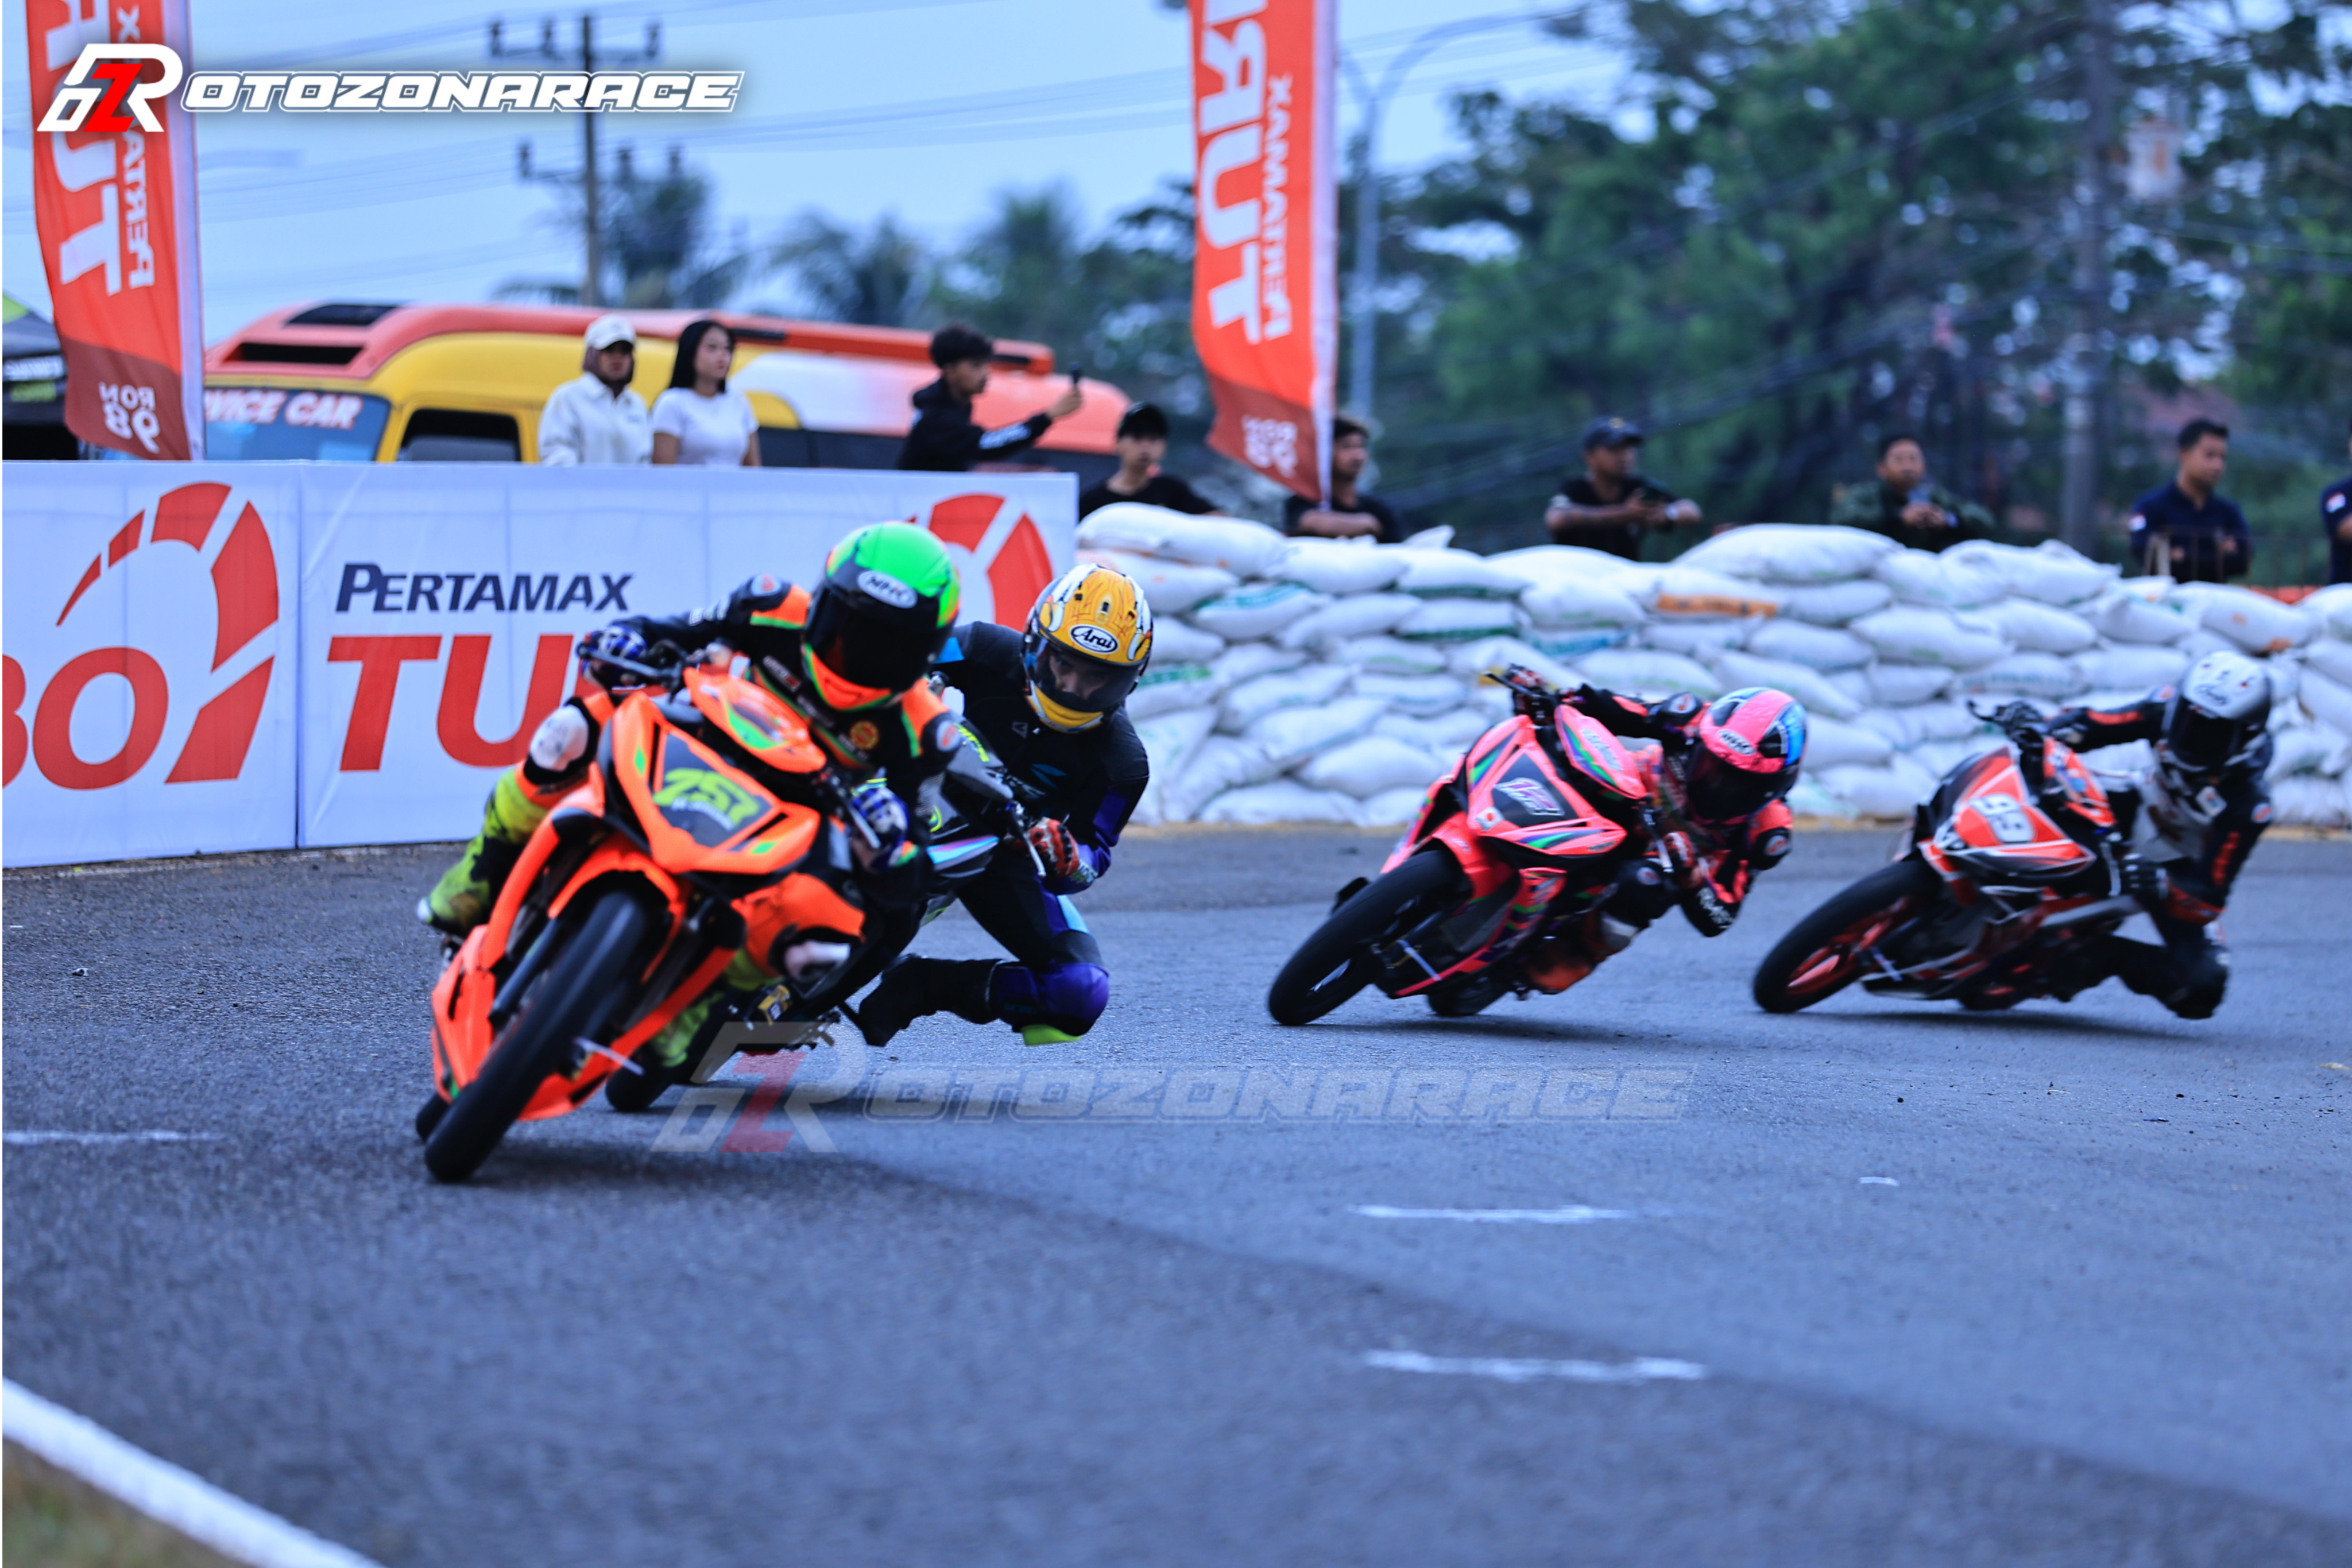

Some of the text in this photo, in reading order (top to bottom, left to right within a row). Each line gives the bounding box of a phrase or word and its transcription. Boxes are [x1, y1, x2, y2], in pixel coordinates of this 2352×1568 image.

[284, 390, 364, 430] CAR
[336, 562, 635, 613] PERTAMAX
[1073, 629, 1113, 649] Arai
[2, 646, 169, 791] O
[327, 633, 669, 772] TU
